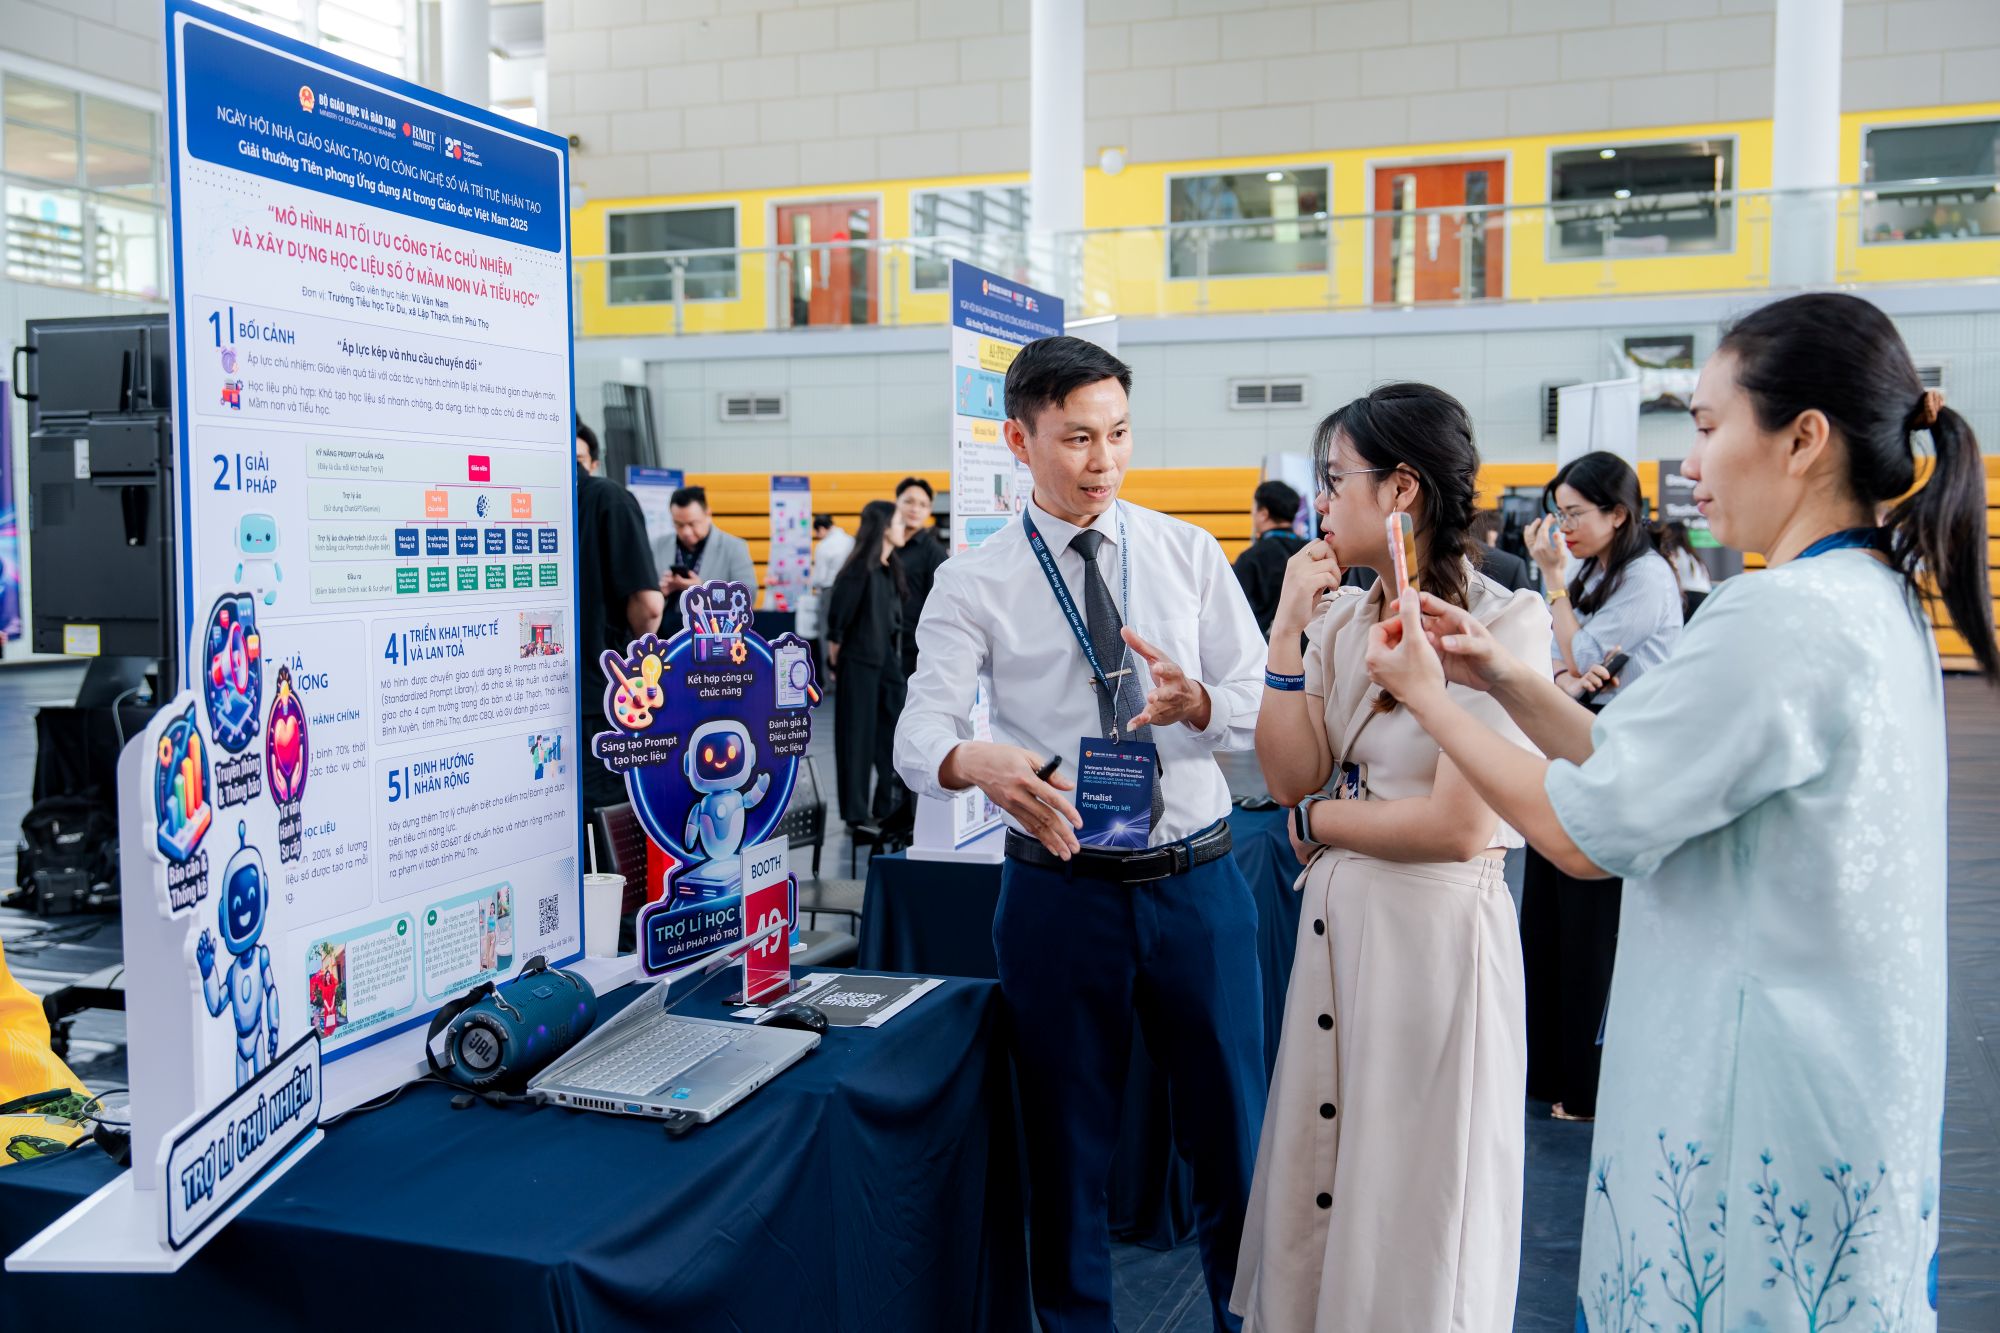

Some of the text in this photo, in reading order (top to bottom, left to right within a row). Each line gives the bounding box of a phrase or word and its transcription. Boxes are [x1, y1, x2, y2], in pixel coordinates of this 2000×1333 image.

[412, 125, 436, 144] RMIT
[217, 105, 541, 213] NGÀY HỘI NHÀ GIÁO SÁNG TẠO VỚI CÔNG NGHỆ SỐ VÀ TRÍ TUỆ NHÂN TẠO
[238, 140, 528, 231] Giải thưởng Tiên phong Ứng dụng AI trong Giáo dục Việt Nam 2025
[268, 205, 512, 276] “MÔ HÌNH AI TỐI ƯU CÔNG TÁC CHỦ NHIỆM
[232, 228, 252, 247] VÀ
[256, 234, 283, 254] XÂY
[288, 241, 327, 263] DỰNG
[330, 250, 357, 272] HỌC
[361, 255, 384, 278] LIỆU
[387, 260, 402, 279] SỐ
[405, 262, 414, 282] Ở
[417, 266, 444, 288] MẦM
[447, 276, 470, 293] NON
[472, 279, 487, 297] VÀ
[489, 282, 510, 301] TIỂU
[240, 319, 294, 344] BỐI CẢNH
[356, 343, 369, 357] lực
[372, 345, 387, 360] kép
[389, 348, 399, 359] và
[401, 350, 416, 362] nhu
[418, 352, 432, 364] cầu
[434, 355, 463, 370] chuyển
[245, 451, 268, 470] GIẢI
[246, 476, 276, 493] PHÁP
[410, 618, 498, 642] TRIỂN KHAI THỰC TẾ
[410, 640, 464, 661] VÀ LAN TOẢ
[688, 674, 702, 684] Kết
[704, 674, 719, 684] hợp
[722, 673, 741, 683] công
[700, 686, 741, 696] chức năng
[313, 708, 360, 726] HÀNH CHÍNH
[769, 719, 788, 728] Đánh
[790, 717, 800, 728] giá
[602, 736, 676, 752] Sáng tạo Prompt
[769, 729, 807, 741] Điều chỉnh
[614, 750, 666, 766] tạo học liệu
[774, 742, 802, 754] học liệu
[413, 752, 473, 777] ĐỊNH HƯỚNG
[414, 771, 469, 794] NHÂN RỘNG
[1082, 792, 1113, 802] Finalist
[1100, 803, 1120, 812] Chung
[320, 820, 336, 836] LIỆU
[752, 854, 782, 879] BOOTH
[655, 908, 734, 941] TRỢ LÍ HỌC
[754, 908, 782, 958] 49
[668, 926, 738, 954] GIẢI PHÁP HỖ TRỢ
[468, 1032, 493, 1062] JBL
[182, 1064, 312, 1209] TRỢ LÍ CHỦ NHIỆM
